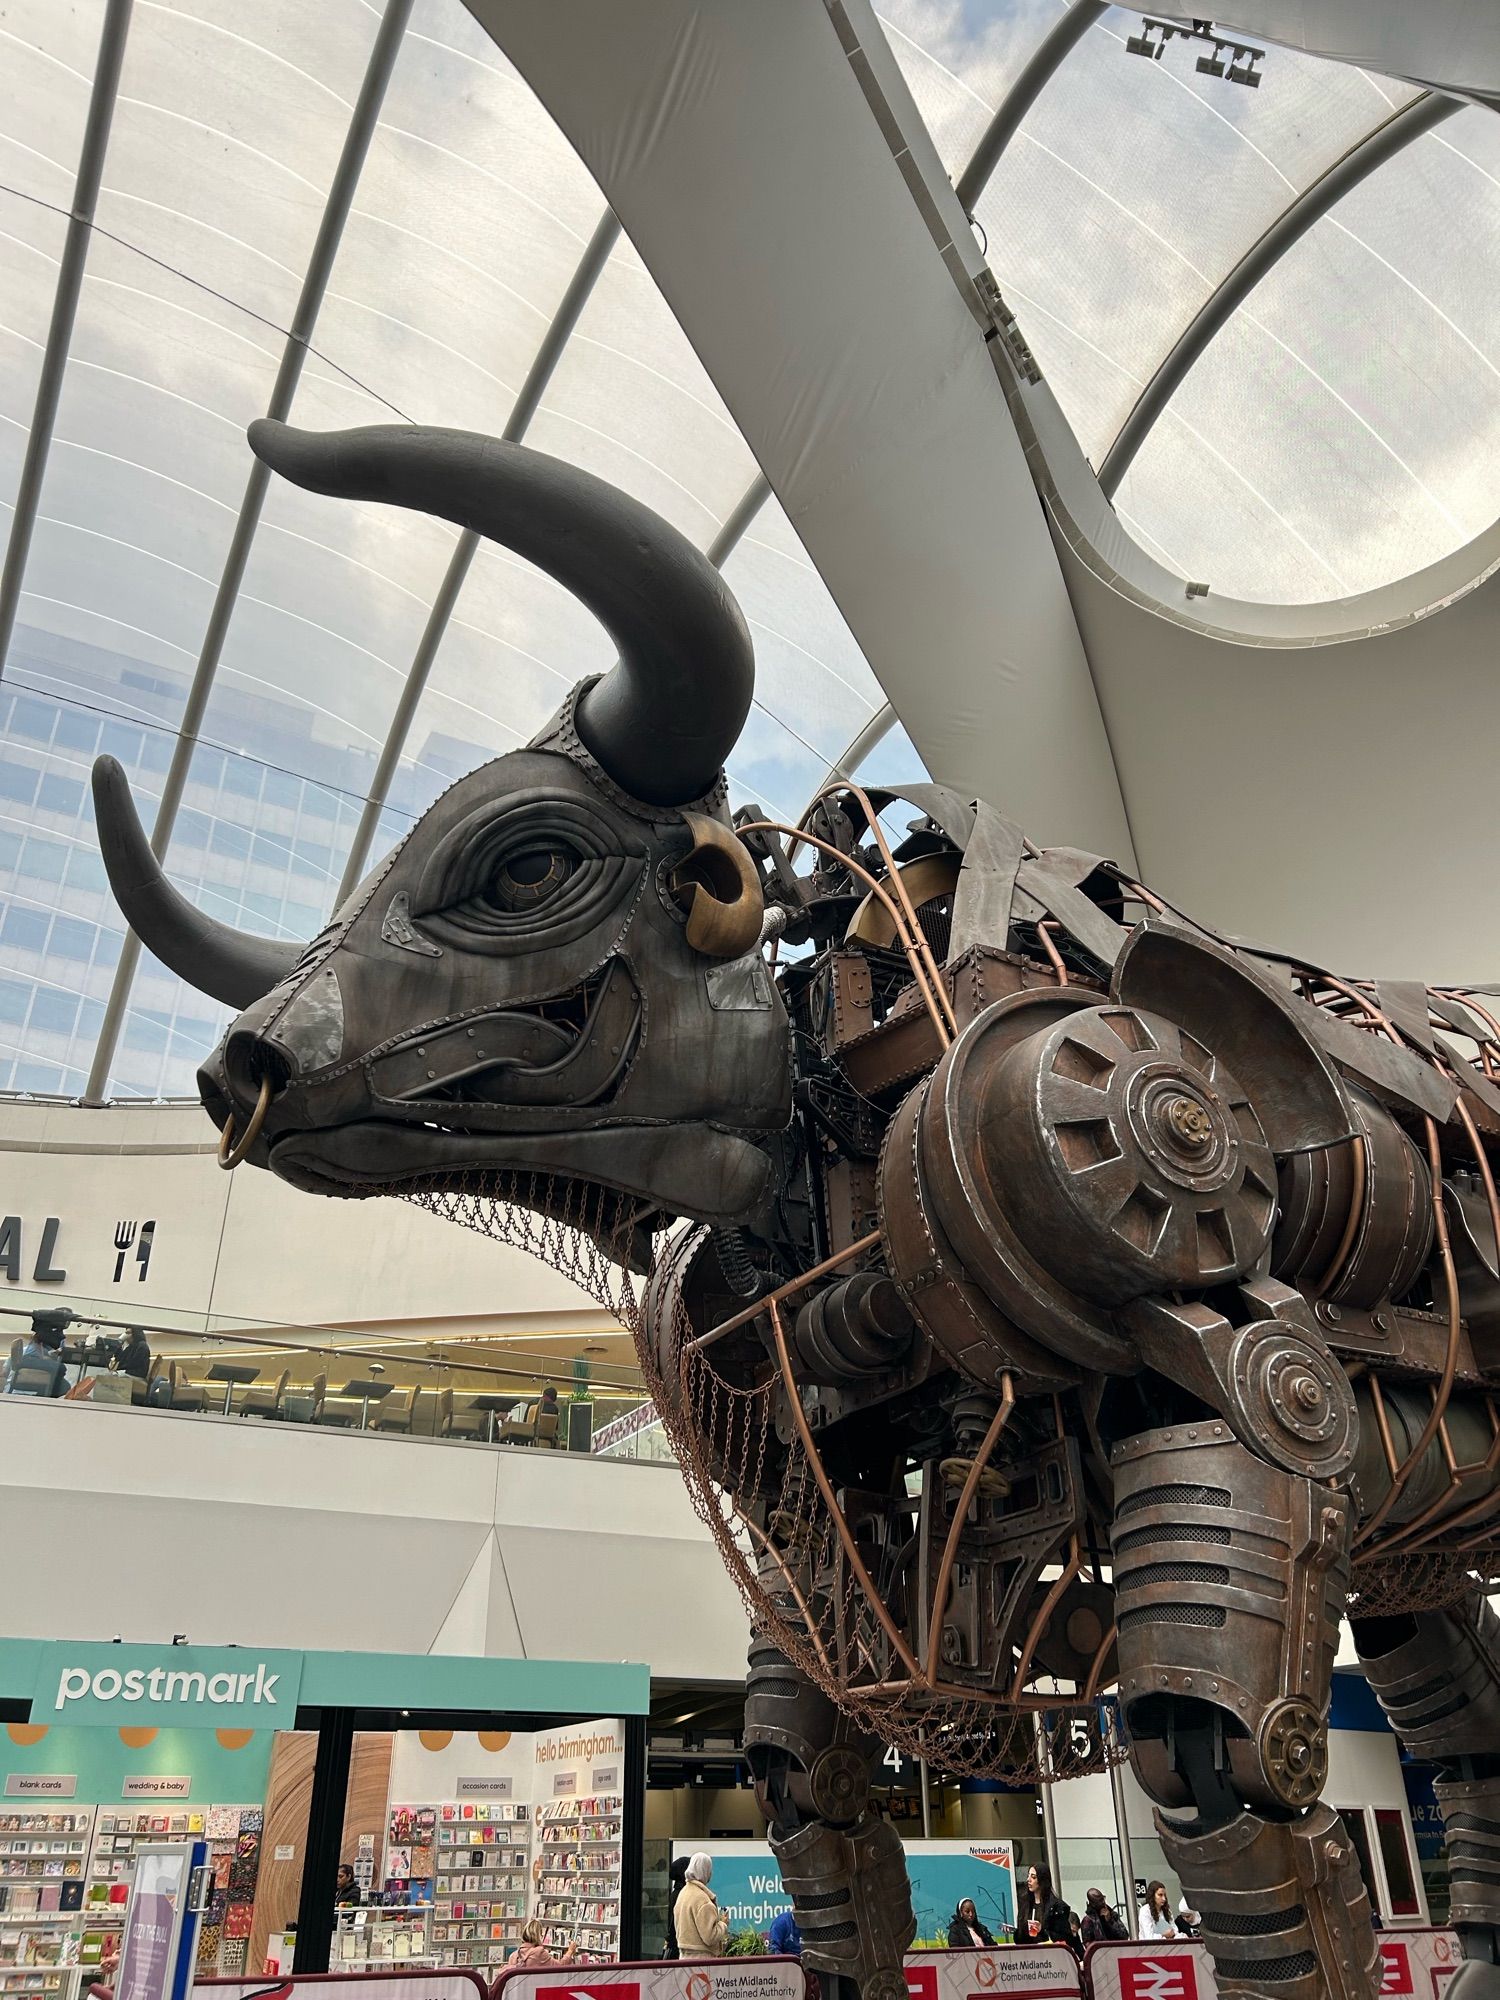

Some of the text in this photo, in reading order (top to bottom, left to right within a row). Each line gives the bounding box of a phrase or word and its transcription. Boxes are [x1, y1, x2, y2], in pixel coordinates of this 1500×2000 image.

[0, 1215, 67, 1282] AL
[55, 1663, 281, 1710] postmark
[1070, 1719, 1092, 1759] 5
[535, 1731, 623, 1764] hello birmingham...
[883, 1741, 903, 1773] 4
[19, 1781, 62, 1789] blank cards
[128, 1782, 184, 1791] wedding & baby
[490, 1782, 507, 1790] cards
[1135, 1883, 1147, 1894] 5a
[1000, 1960, 1052, 1971] West Midlands
[716, 1975, 778, 1987] West Midlands
[1001, 1970, 1068, 1982] Combined Authority
[716, 1985, 797, 2000] Combined Authority
